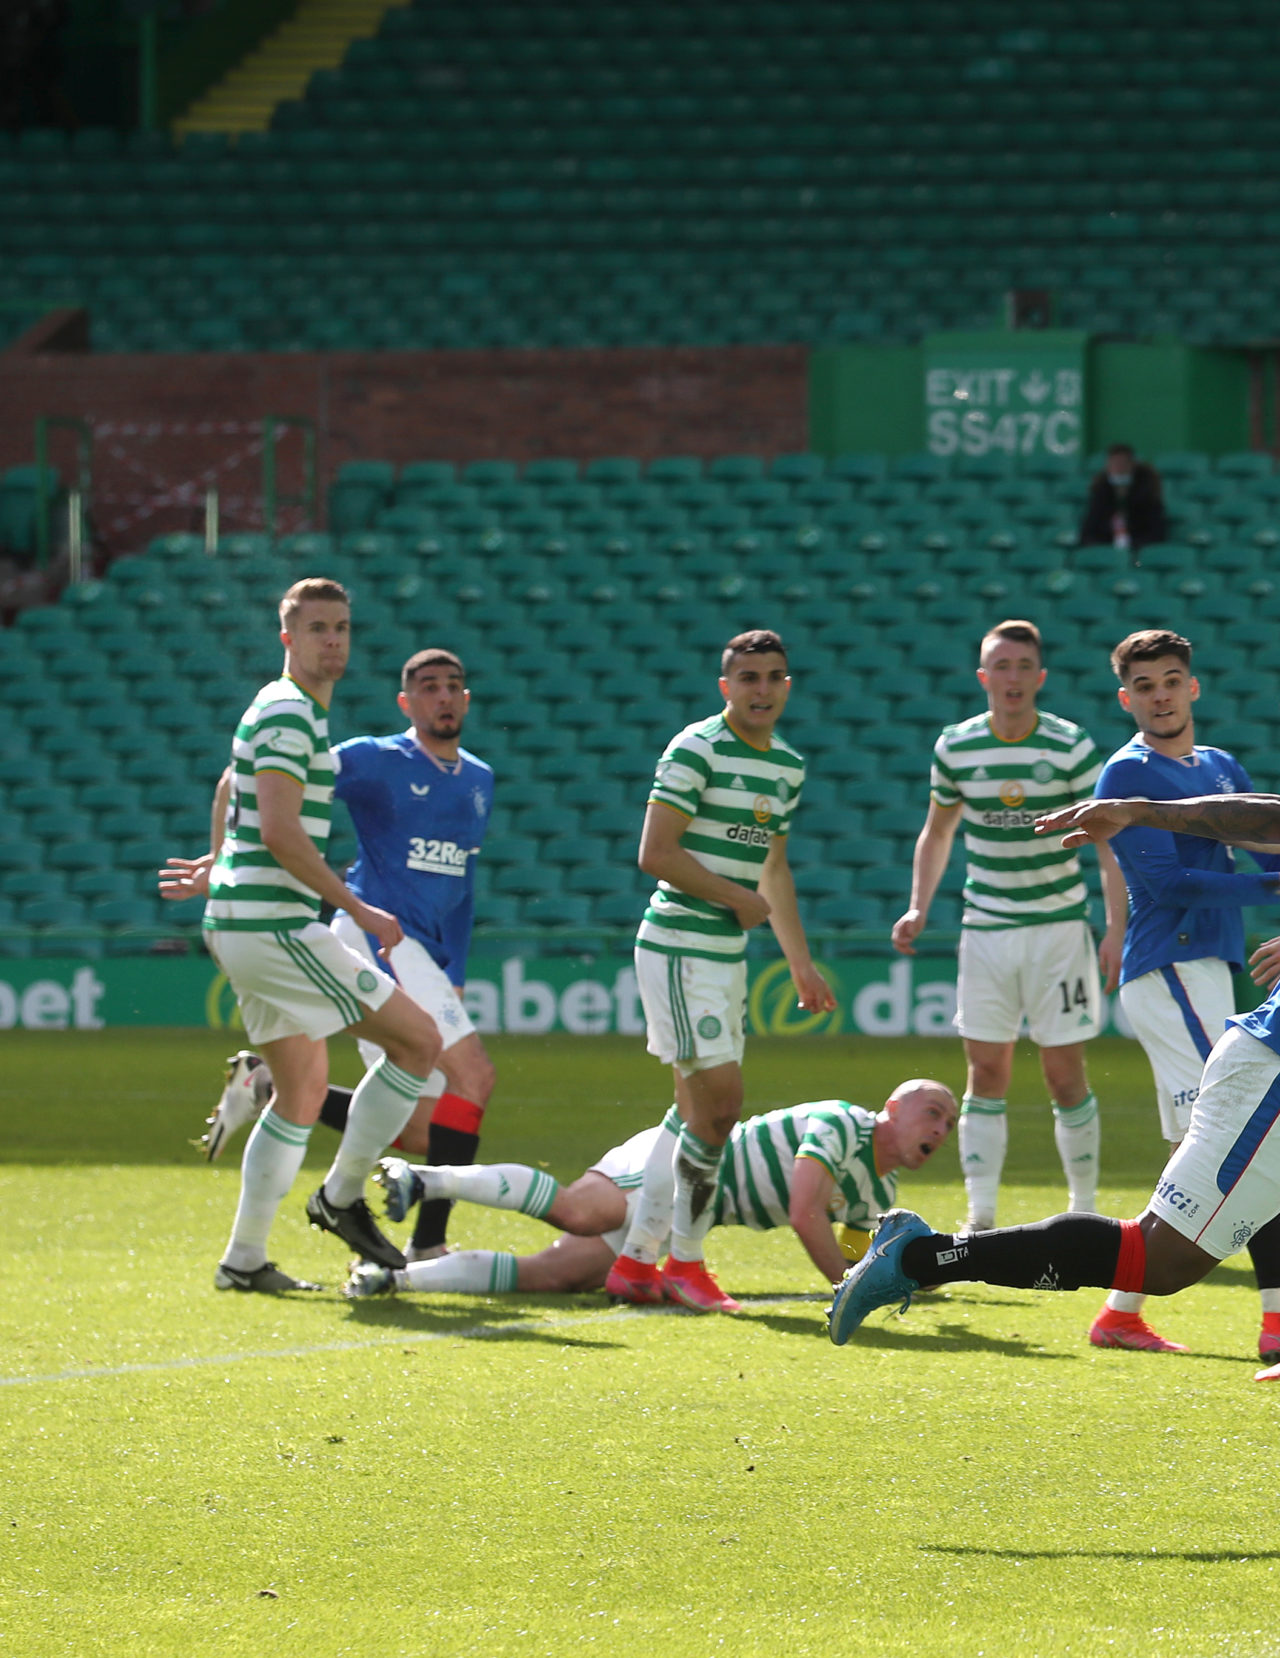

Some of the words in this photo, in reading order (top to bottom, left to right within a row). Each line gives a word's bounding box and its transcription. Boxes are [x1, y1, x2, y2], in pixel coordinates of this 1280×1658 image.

[927, 369, 1013, 406] EXIT
[928, 411, 1081, 456] SS47C
[726, 822, 769, 846] dafab
[464, 957, 646, 1035] abet
[1061, 977, 1089, 1013] 14
